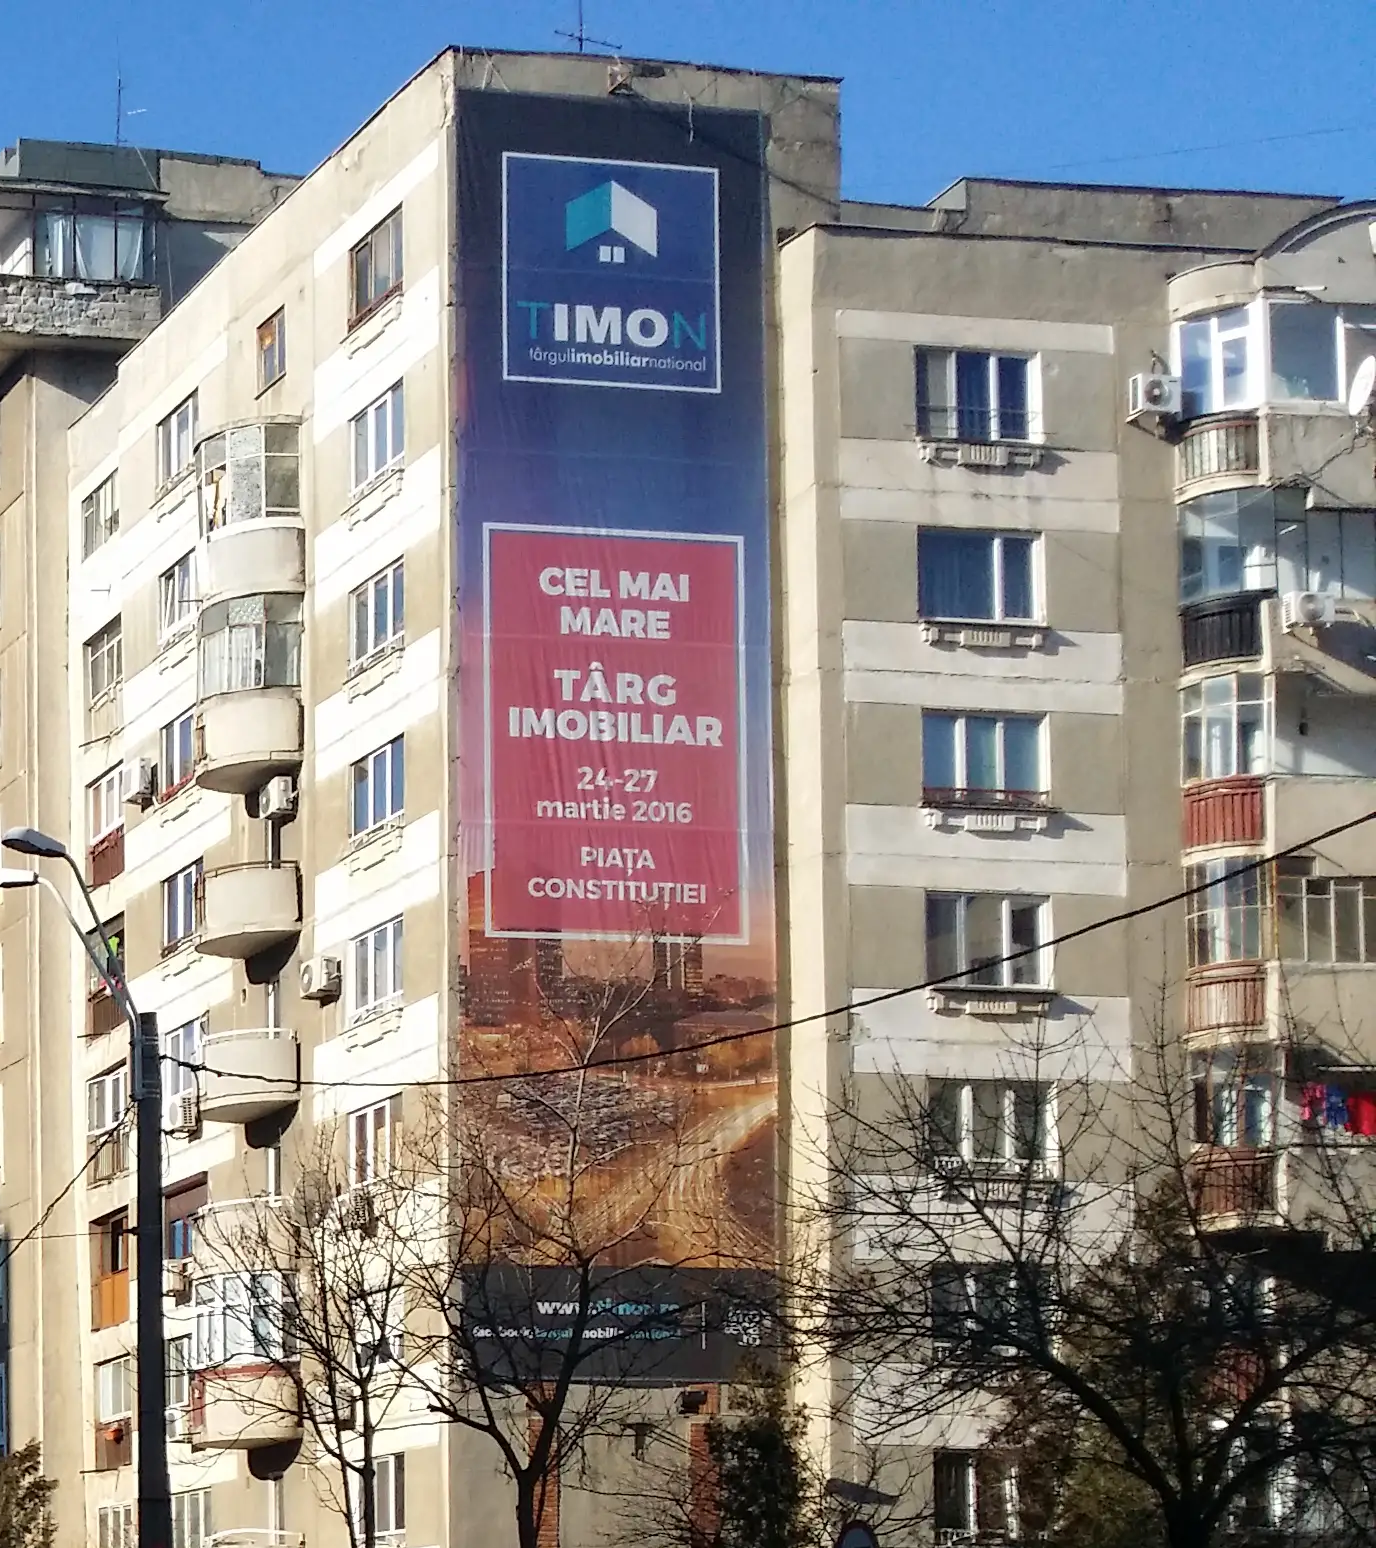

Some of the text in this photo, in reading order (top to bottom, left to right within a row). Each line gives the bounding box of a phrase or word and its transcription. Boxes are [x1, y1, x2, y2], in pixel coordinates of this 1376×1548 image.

[517, 301, 707, 350] TIMON
[538, 567, 690, 602] CEL MAI
[560, 606, 671, 640] MARE
[553, 661, 677, 707] TÂRG
[509, 707, 723, 747] IMOBILIAR
[577, 766, 658, 793] 24-27
[537, 797, 693, 824] martie 2016
